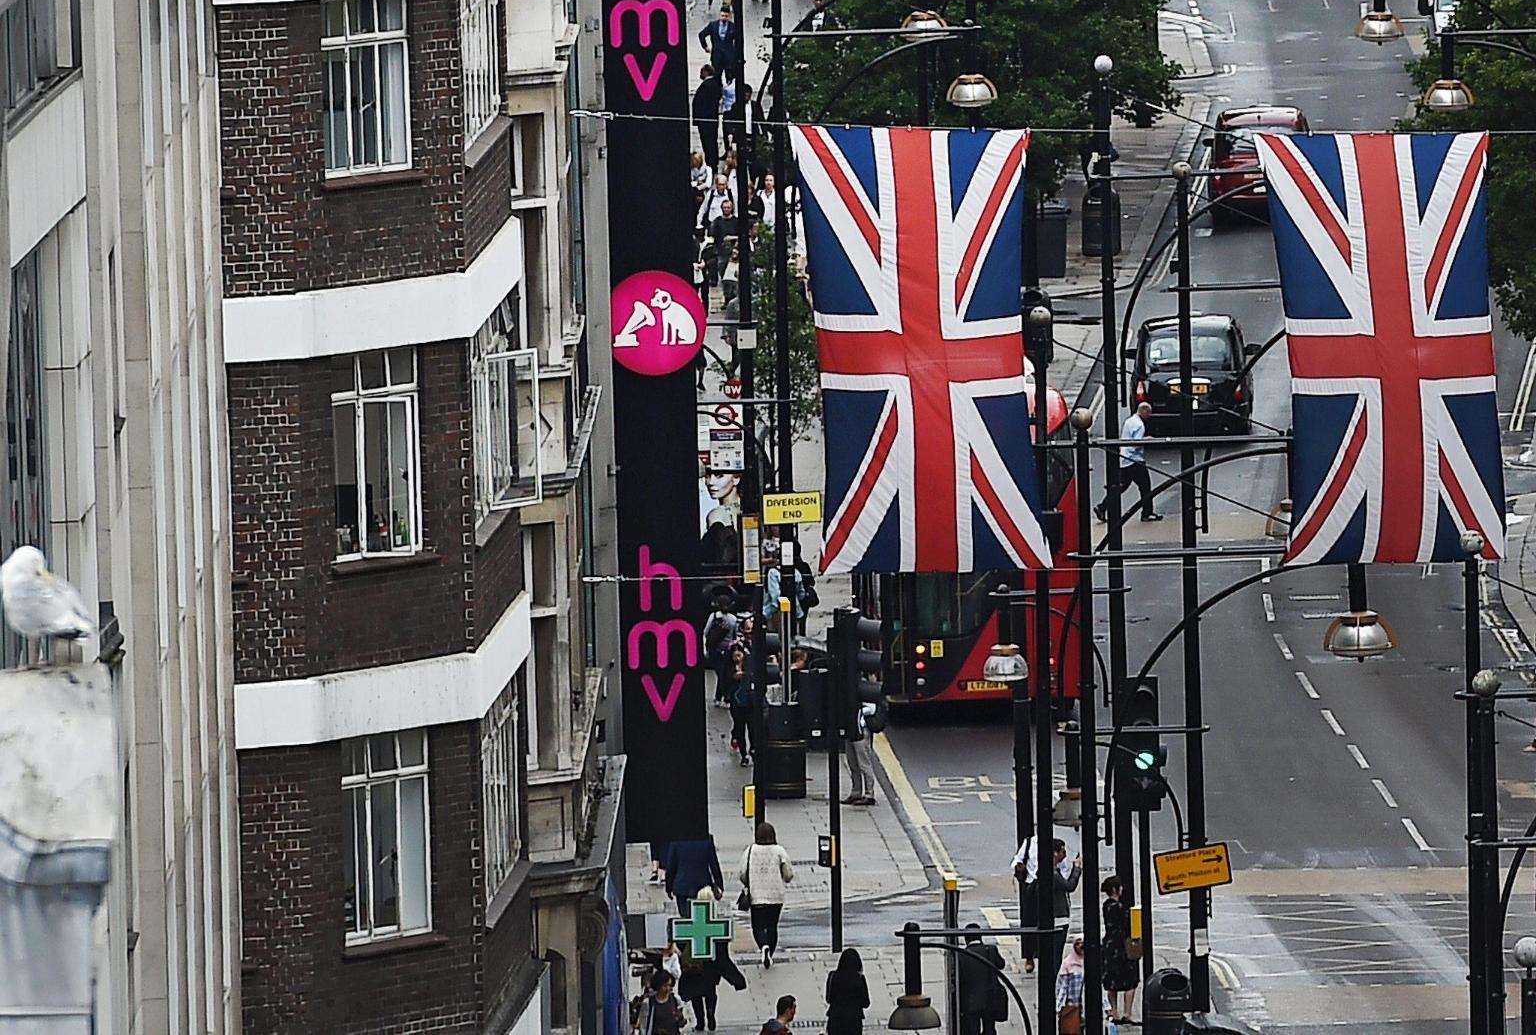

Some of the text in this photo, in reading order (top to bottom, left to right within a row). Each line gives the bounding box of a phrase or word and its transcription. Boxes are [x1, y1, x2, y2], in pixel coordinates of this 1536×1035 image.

[766, 496, 817, 508] DIVERSION
[782, 510, 803, 519] END
[627, 545, 697, 722] hmv
